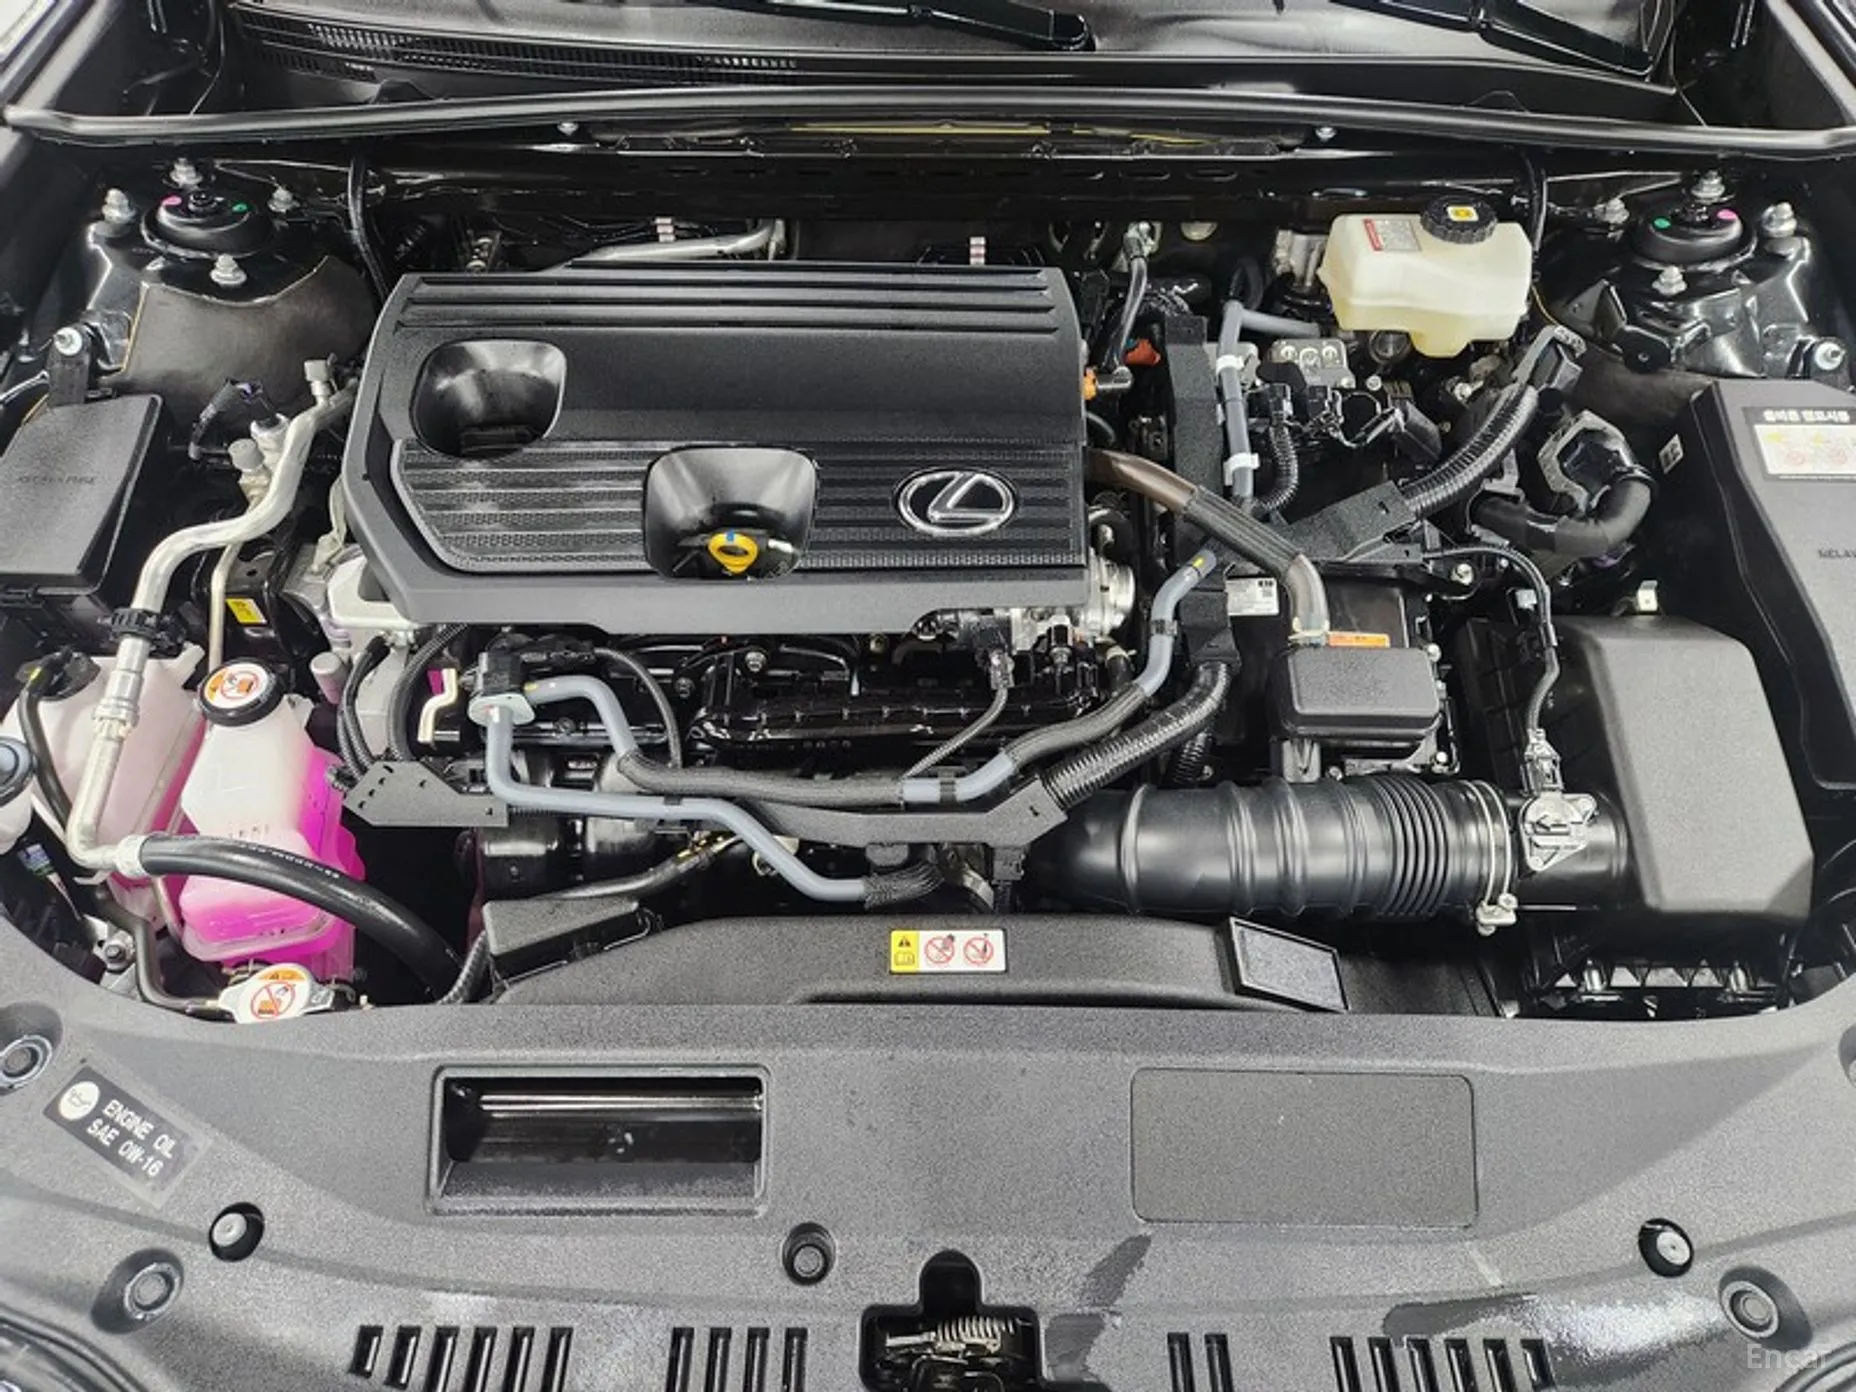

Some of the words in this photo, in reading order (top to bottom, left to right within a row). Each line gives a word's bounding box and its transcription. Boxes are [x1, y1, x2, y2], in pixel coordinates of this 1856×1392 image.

[86, 1118, 120, 1147] SAE
[118, 1140, 164, 1177] 0W-16
[102, 1099, 155, 1140] ENGINE
[153, 1134, 176, 1159] OIL
